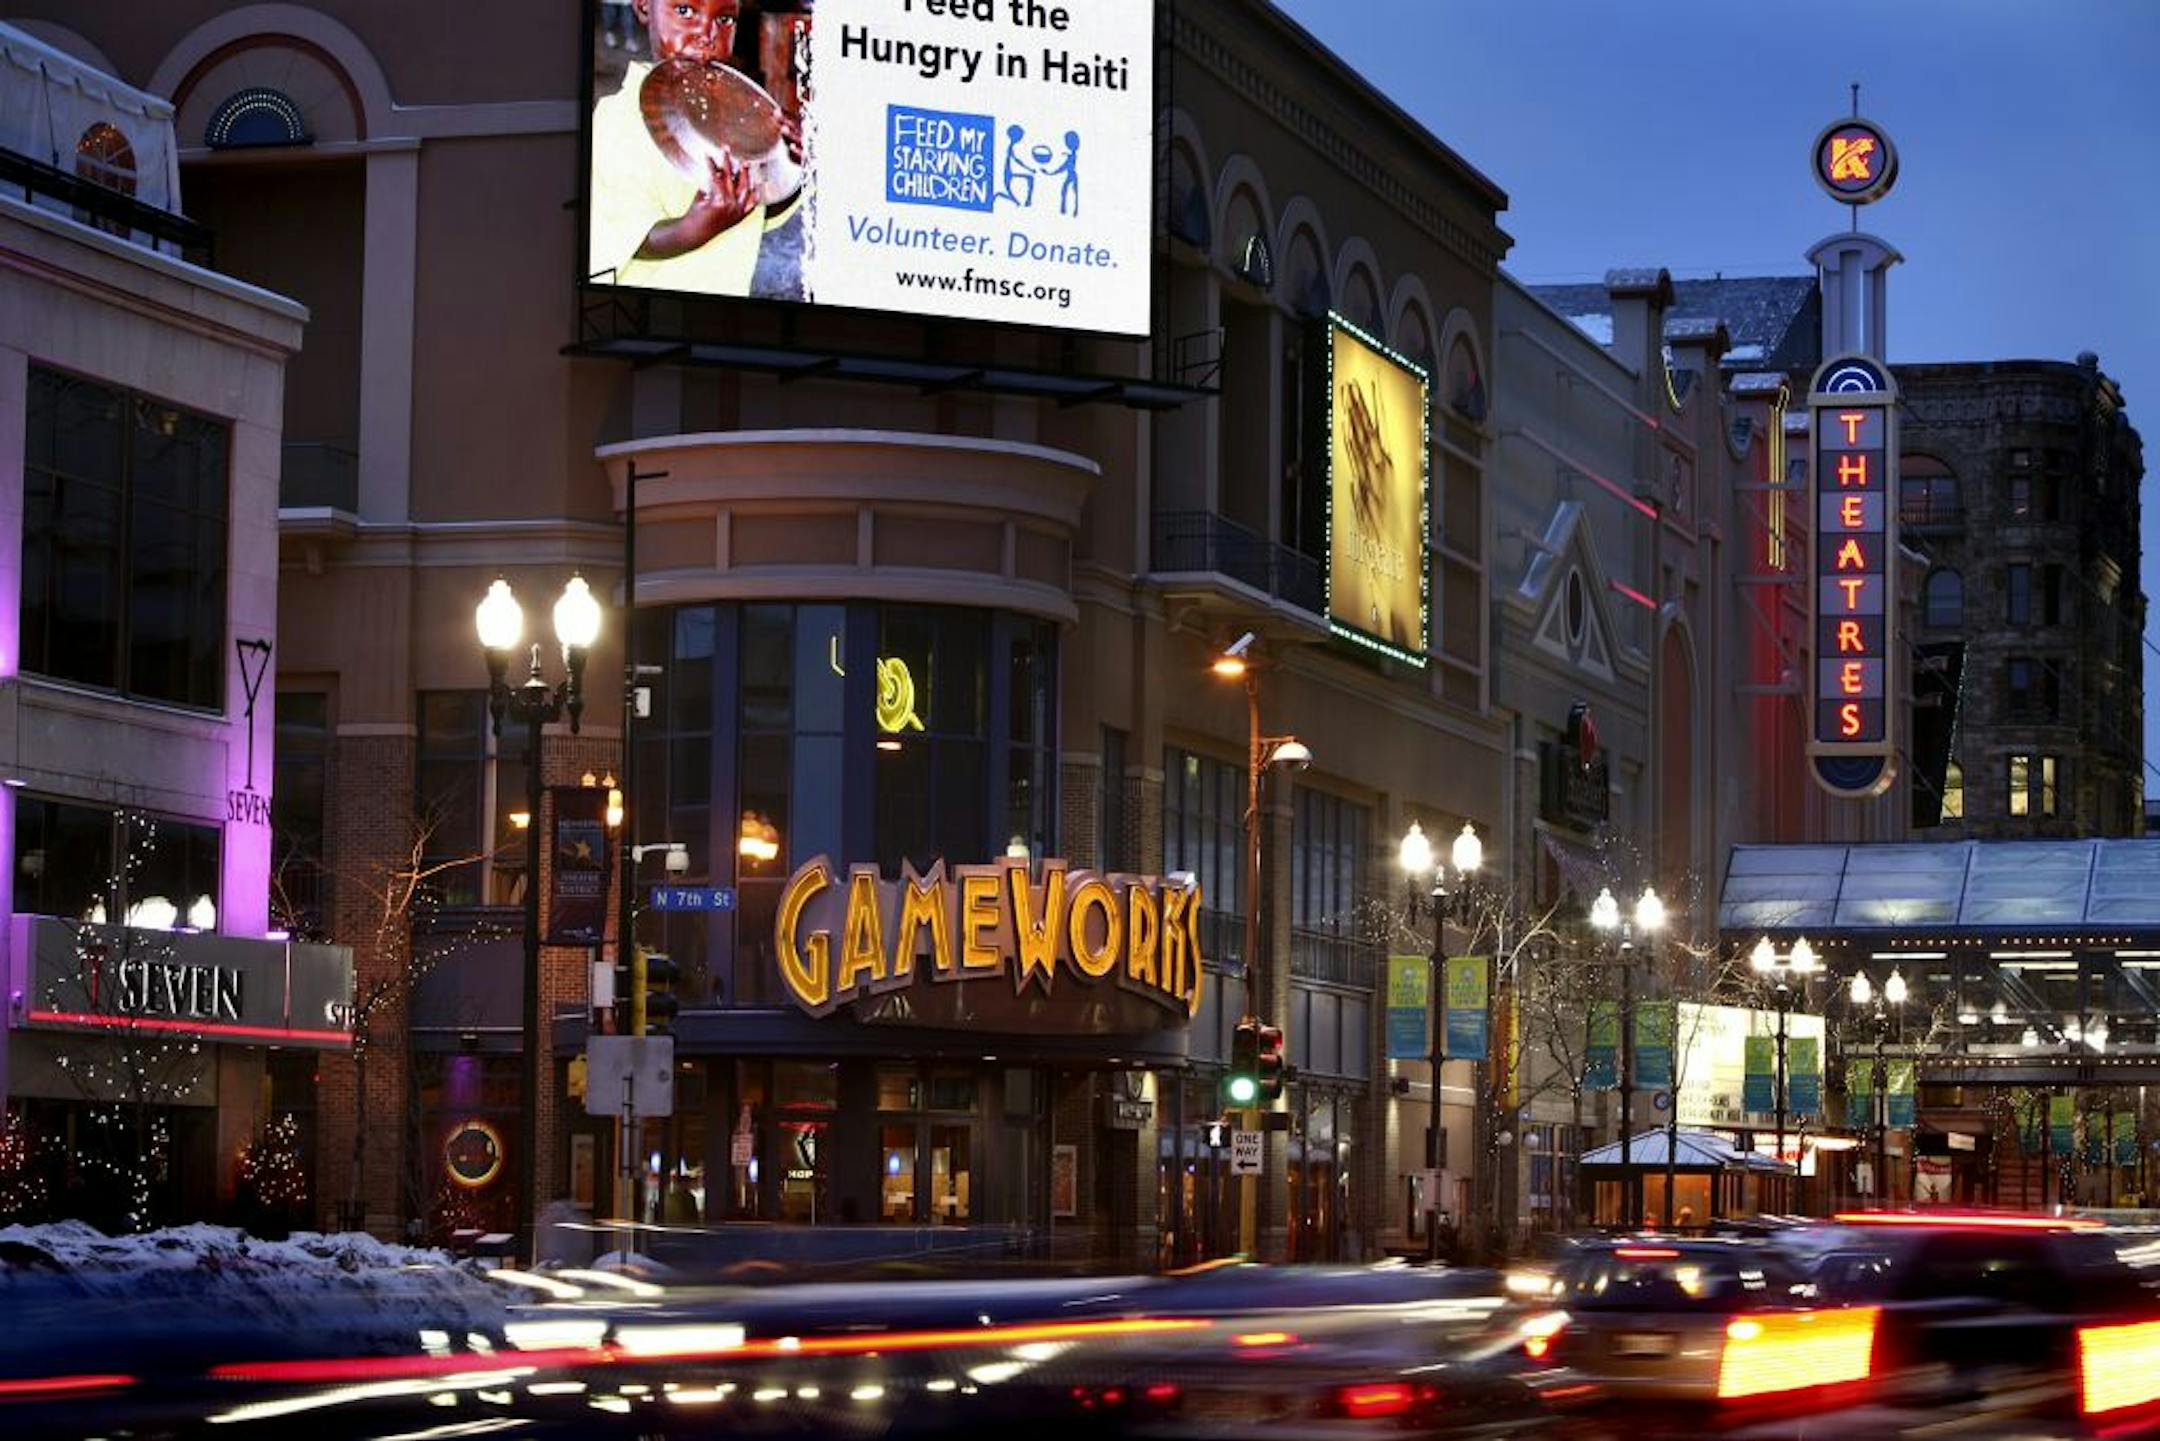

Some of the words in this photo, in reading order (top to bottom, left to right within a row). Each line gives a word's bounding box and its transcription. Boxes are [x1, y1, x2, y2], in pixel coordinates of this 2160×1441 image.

[1008, 0, 1070, 31] the
[841, 24, 982, 83] Hungry
[996, 42, 1027, 79] in
[1042, 48, 1128, 91] Haiti
[895, 112, 955, 149] FEED
[960, 126, 987, 153] MY
[893, 145, 986, 180] STARVING
[893, 170, 988, 204] CHILDREN
[848, 214, 994, 255] Volunteer.
[1007, 231, 1118, 268] Donate.
[896, 267, 1071, 309] www.fmsc.org
[1837, 413, 1868, 737] THEATRES
[227, 789, 273, 826] SEVEN
[657, 891, 668, 907] N
[677, 891, 702, 907] 7th
[714, 891, 730, 907] St
[776, 858, 1203, 1020] GAMEWORKS
[118, 957, 241, 1021] SEVEN
[1235, 1133, 1259, 1145] ONE
[1235, 1146, 1259, 1157] WAY
